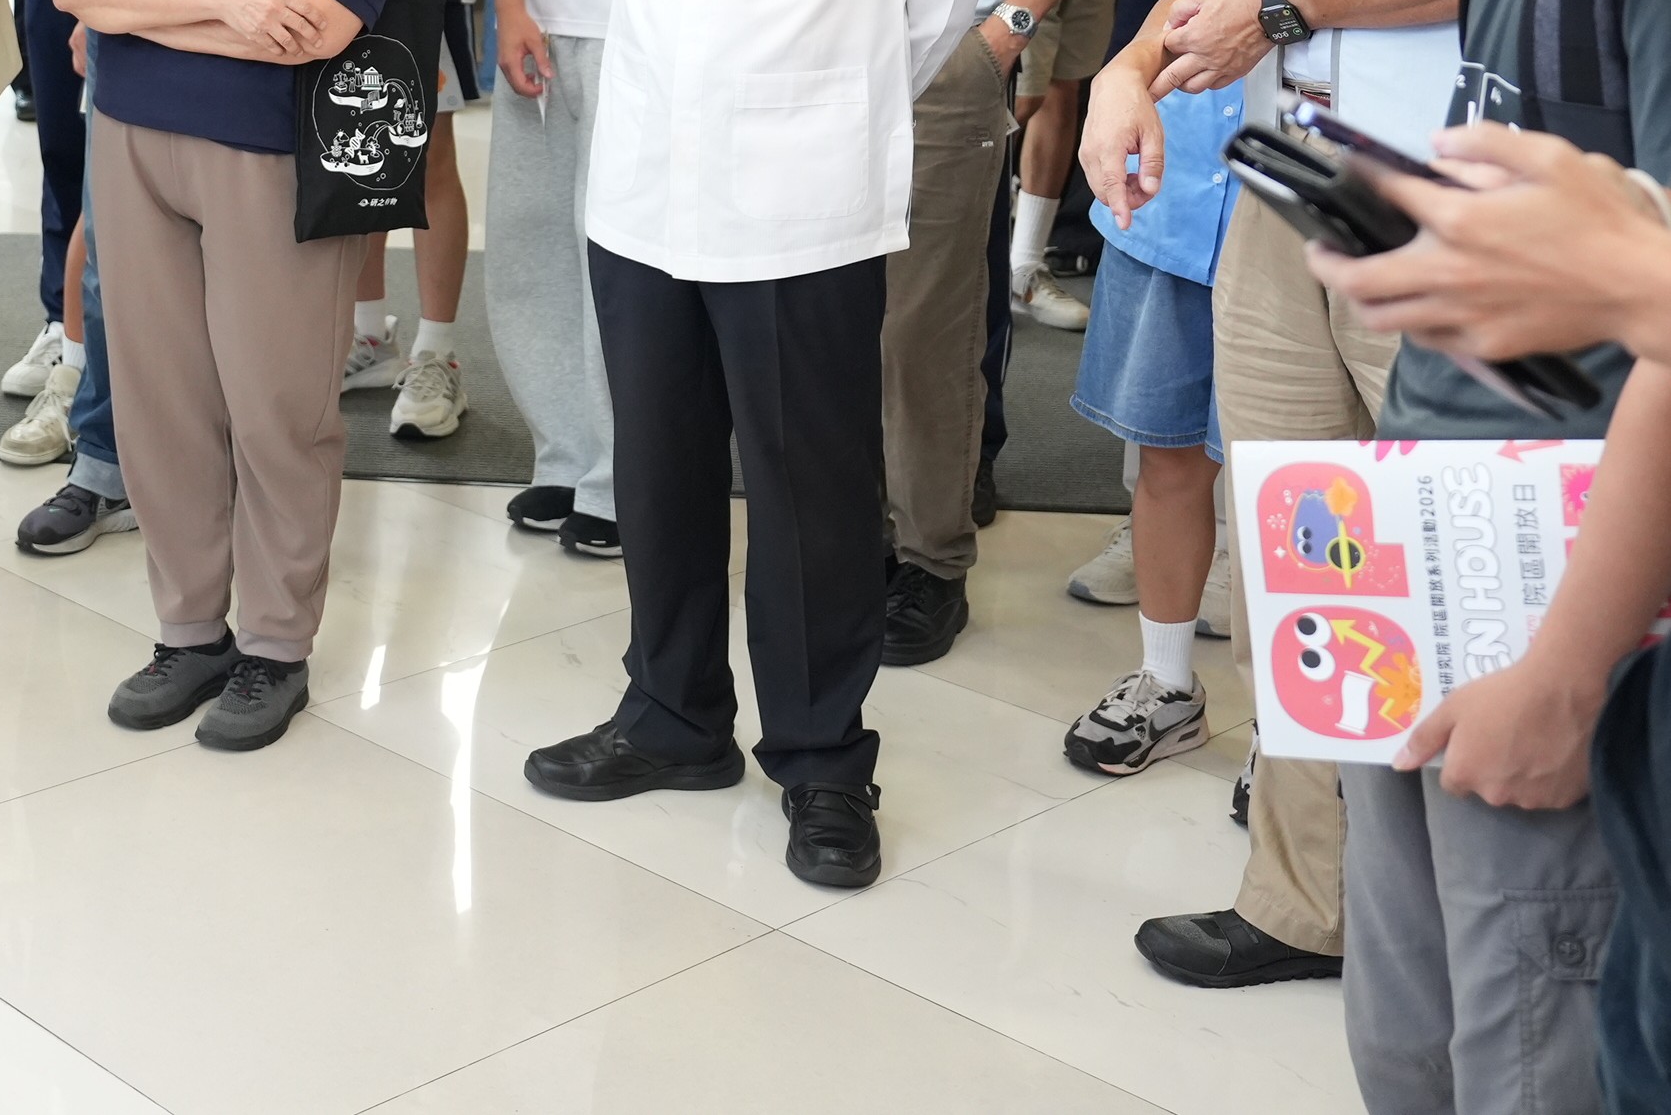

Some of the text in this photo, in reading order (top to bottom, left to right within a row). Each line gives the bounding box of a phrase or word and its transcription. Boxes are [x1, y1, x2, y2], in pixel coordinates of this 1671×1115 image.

[1440, 461, 1506, 612] HOUSE
[1512, 483, 1549, 607] 院區開放日
